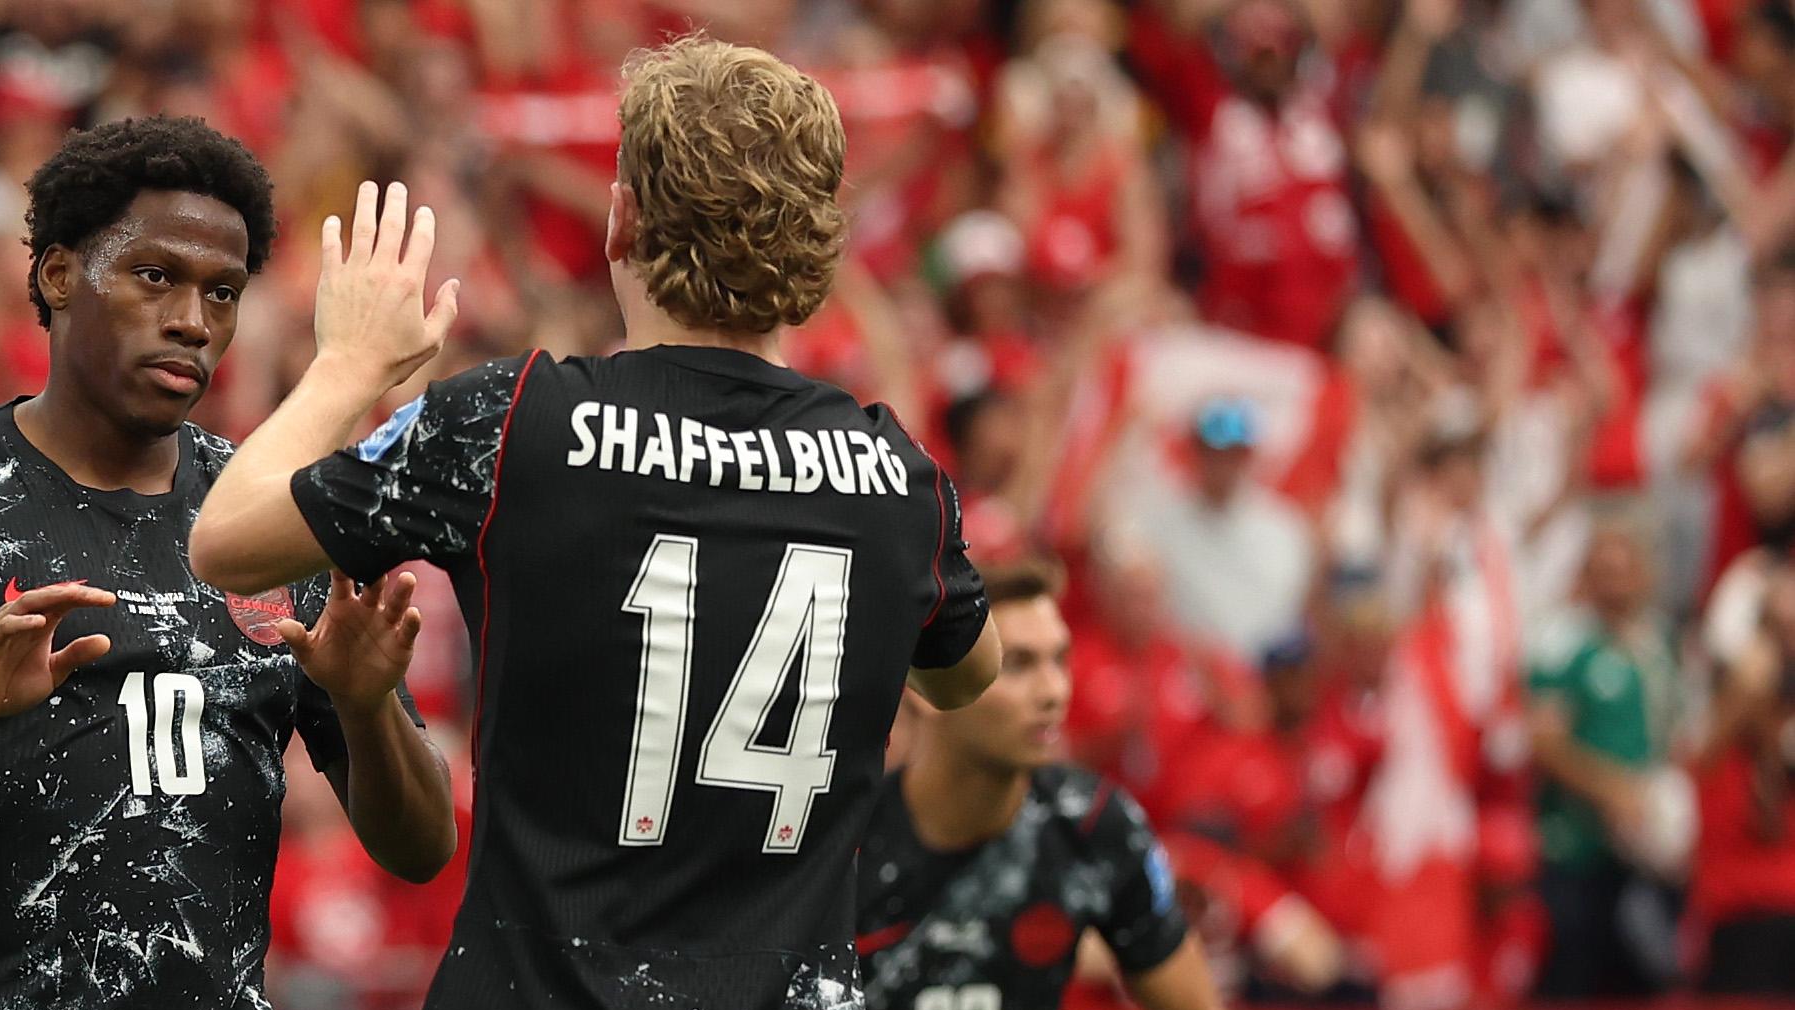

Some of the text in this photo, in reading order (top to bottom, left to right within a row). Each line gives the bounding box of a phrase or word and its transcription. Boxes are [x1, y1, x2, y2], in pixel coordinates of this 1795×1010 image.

[567, 401, 909, 496] SHAFFELBURG
[155, 592, 185, 603] QATAR
[117, 671, 206, 797] 10
[618, 533, 853, 854] 14
